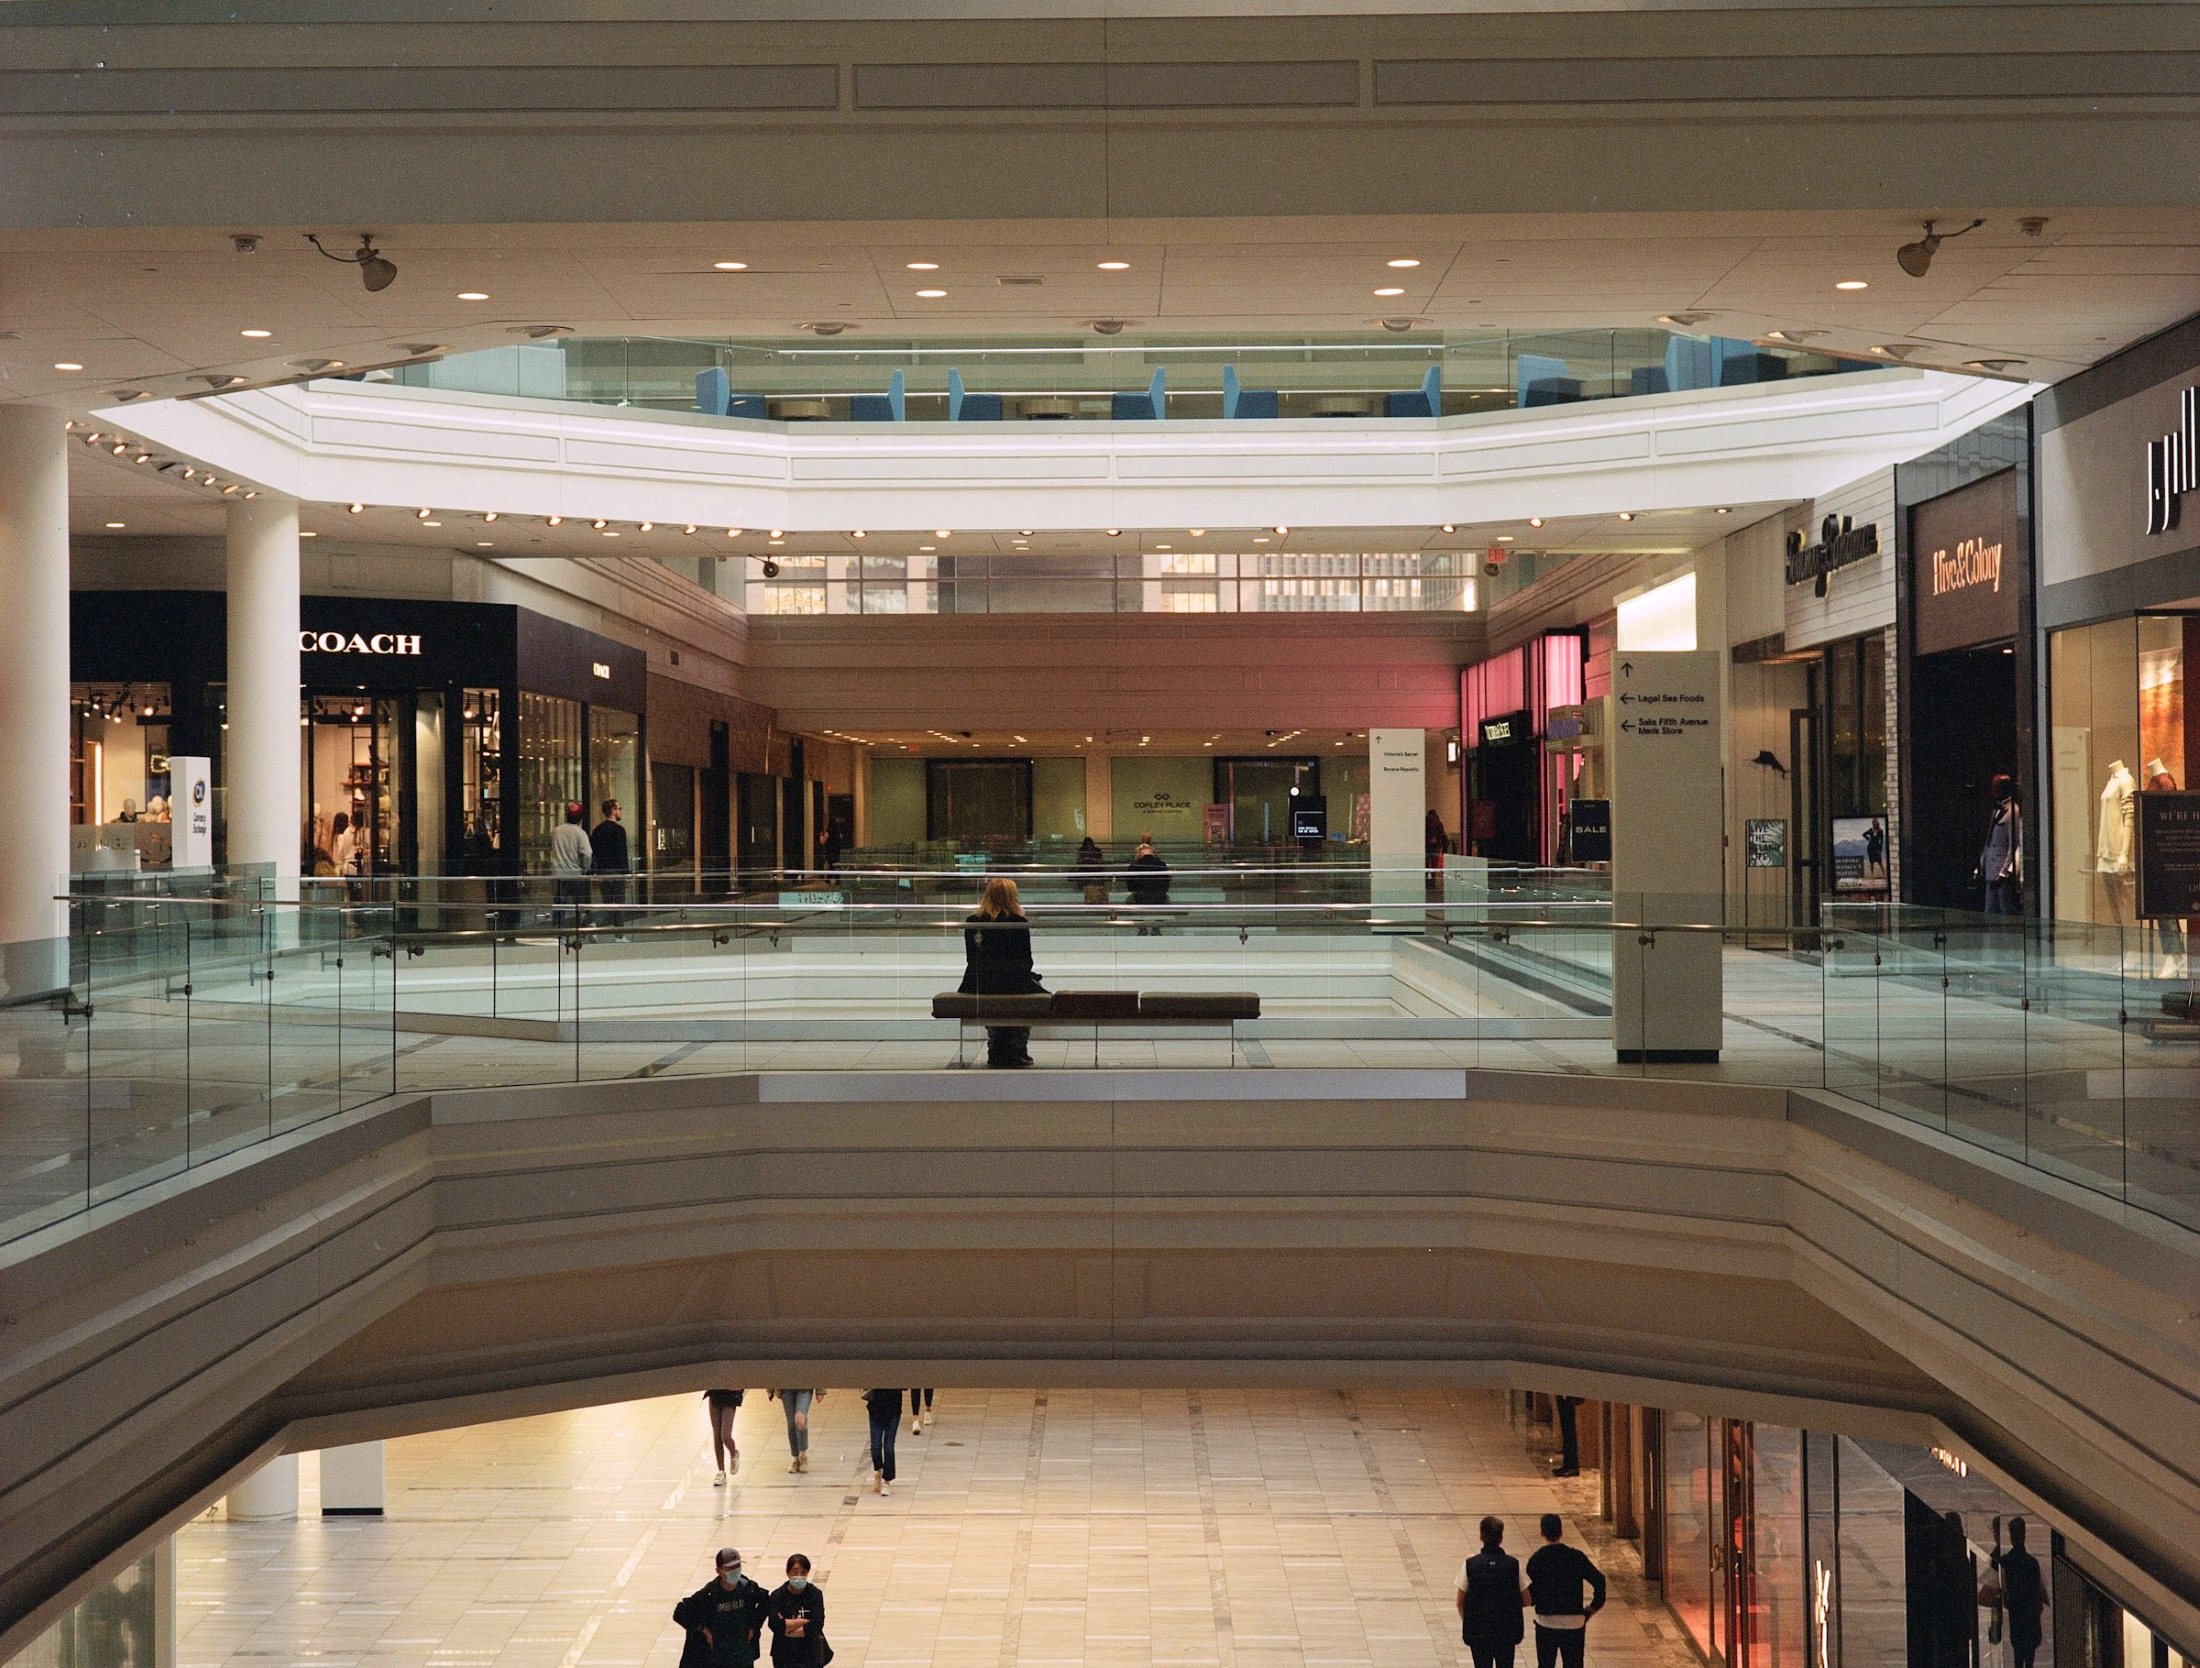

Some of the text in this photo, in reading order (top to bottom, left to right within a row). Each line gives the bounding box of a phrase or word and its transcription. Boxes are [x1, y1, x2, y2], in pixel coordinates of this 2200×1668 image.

[299, 630, 422, 655] COACH
[1638, 694, 1705, 703] Legal Sea Foods
[1638, 717, 1709, 726] Saks Fifth Avenue
[1662, 727, 1683, 735] Store
[1575, 826, 1607, 834] SALE
